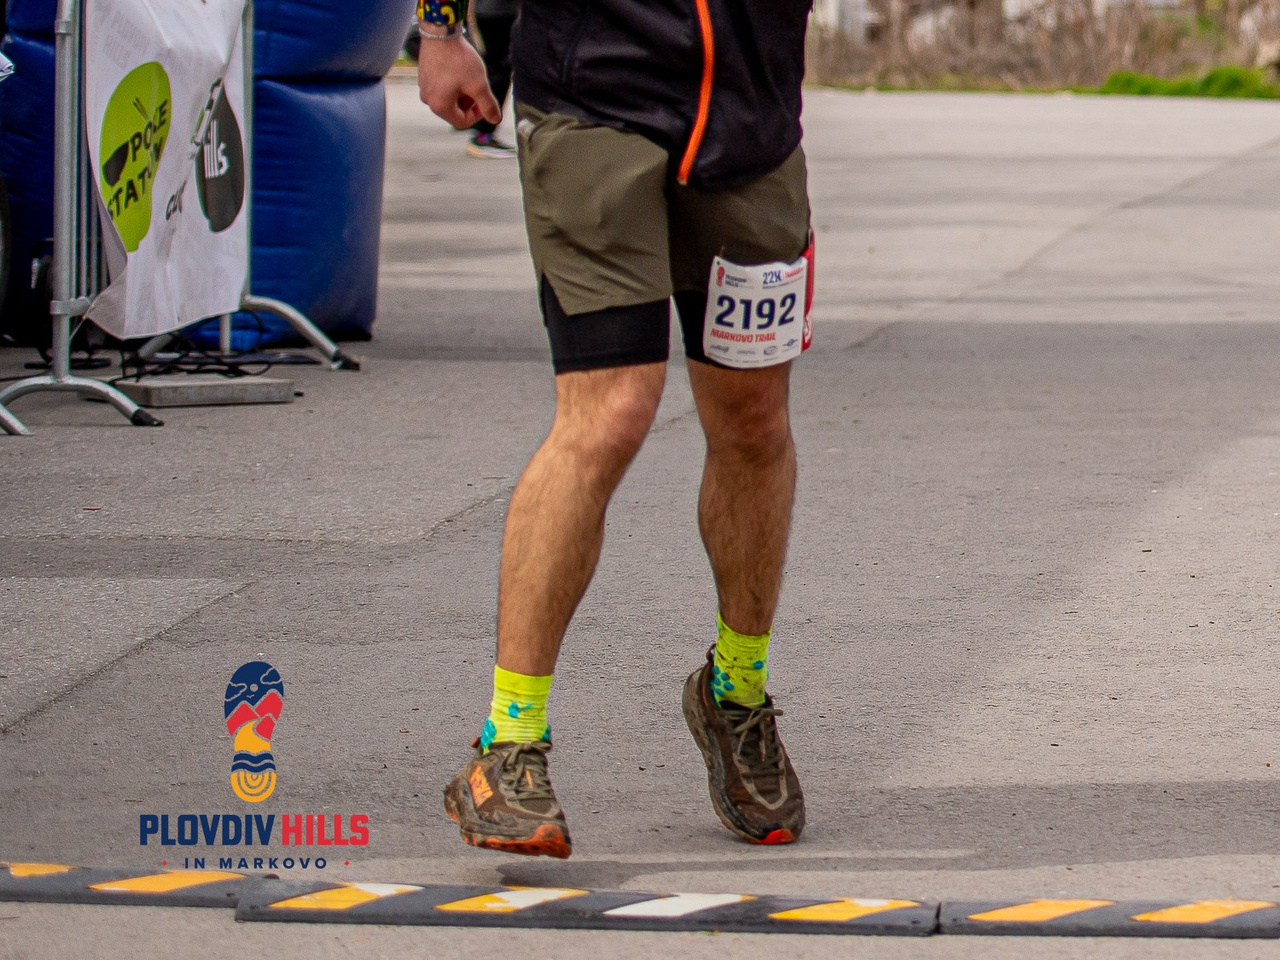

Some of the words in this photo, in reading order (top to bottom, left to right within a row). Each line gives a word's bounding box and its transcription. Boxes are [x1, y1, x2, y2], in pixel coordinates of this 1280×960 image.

[715, 293, 796, 330] 2192
[710, 328, 754, 343] MARKOVO
[755, 332, 776, 343] TRAIL
